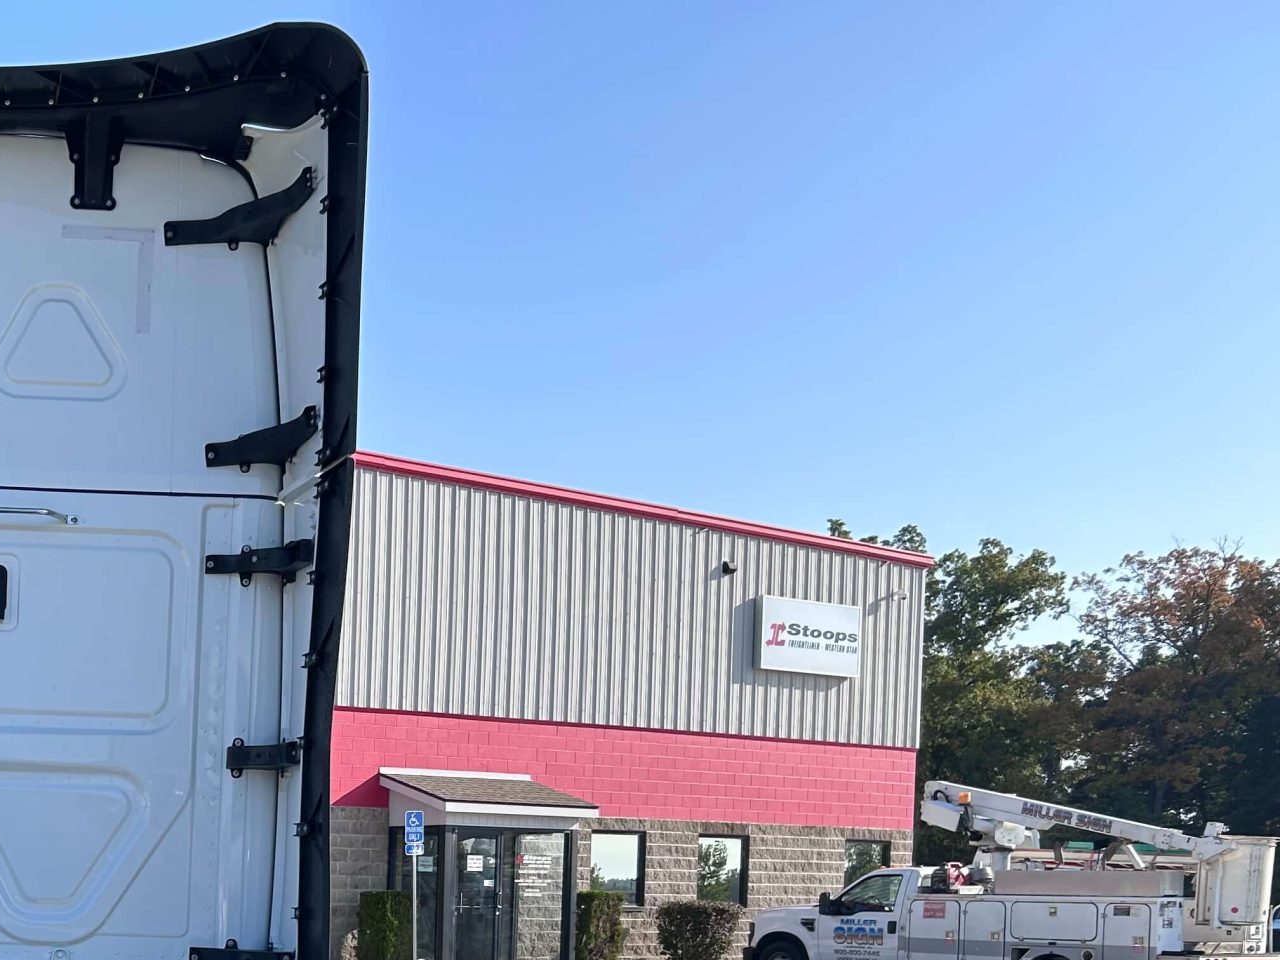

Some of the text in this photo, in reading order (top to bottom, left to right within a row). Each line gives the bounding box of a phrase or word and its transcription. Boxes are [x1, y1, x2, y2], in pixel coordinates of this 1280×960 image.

[787, 623, 858, 643] Stoops
[846, 646, 858, 654] STAR
[1021, 802, 1112, 833] MILLER SIGN
[840, 918, 876, 926] MILLER
[833, 926, 883, 945] SIGN
